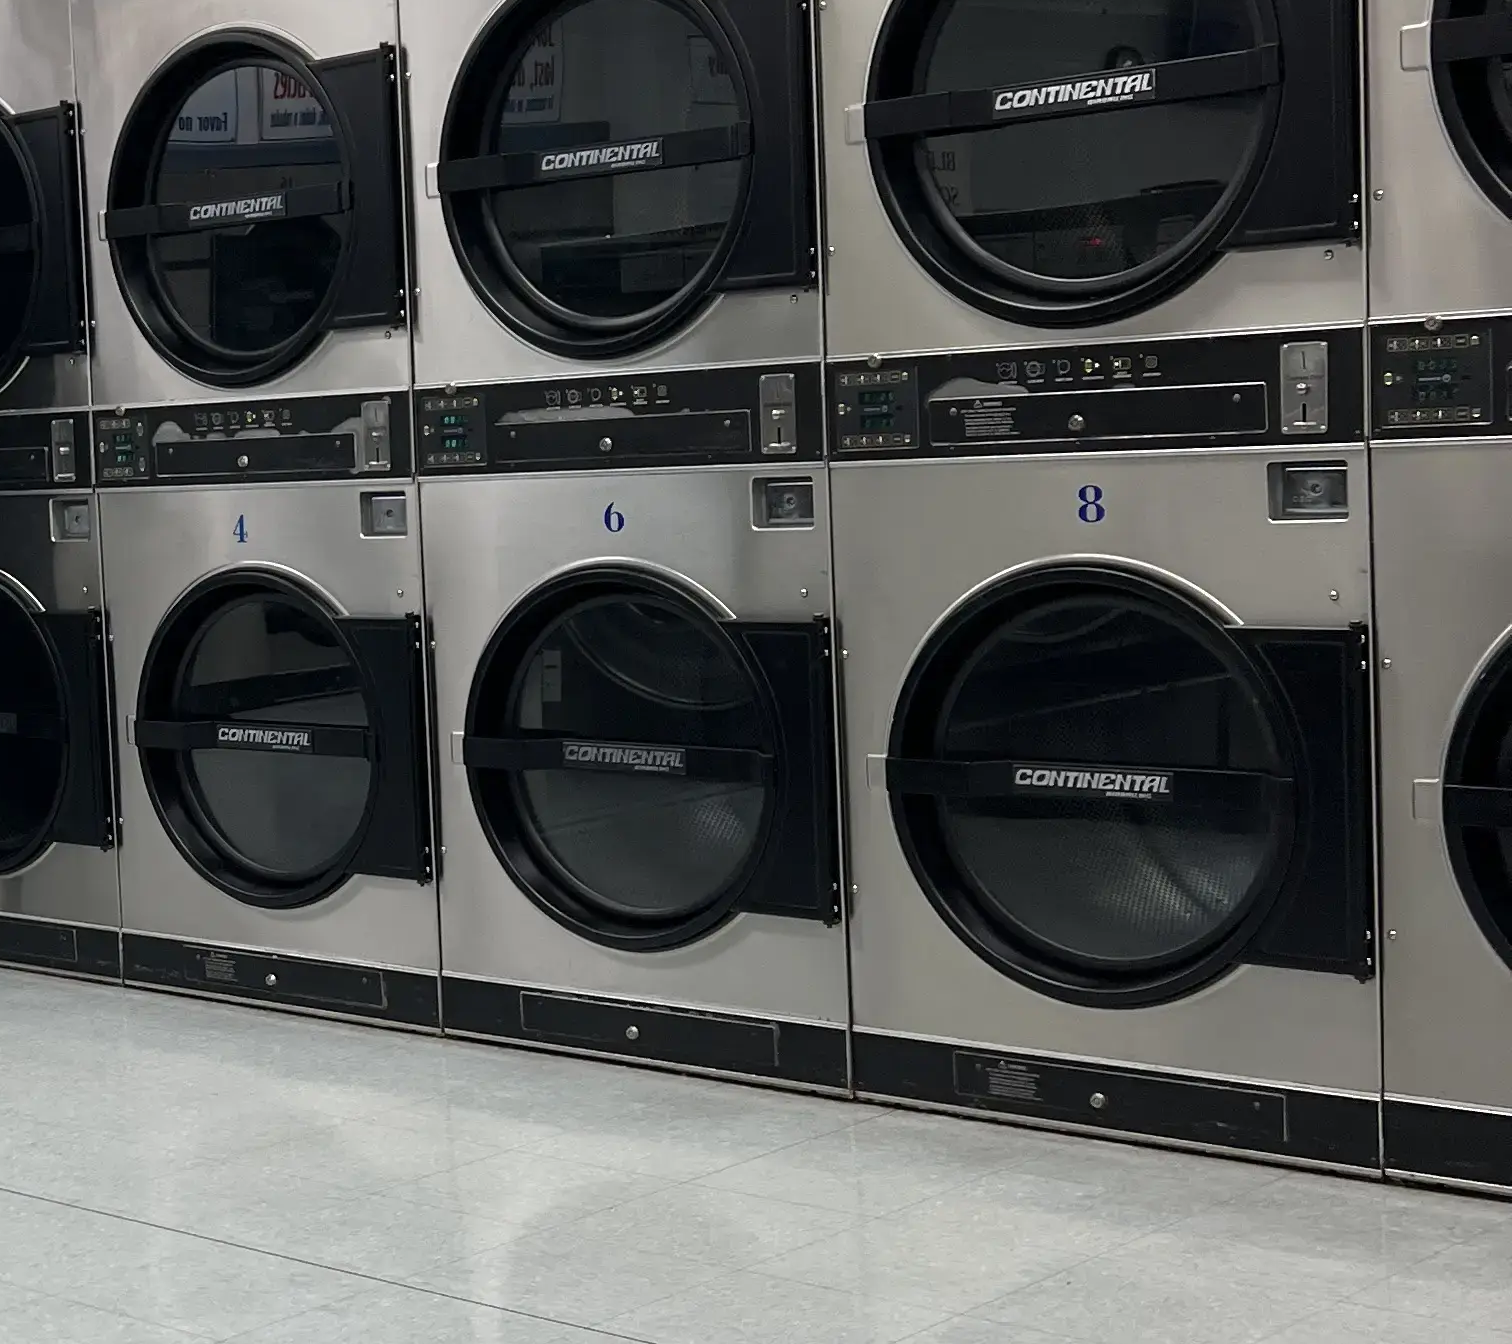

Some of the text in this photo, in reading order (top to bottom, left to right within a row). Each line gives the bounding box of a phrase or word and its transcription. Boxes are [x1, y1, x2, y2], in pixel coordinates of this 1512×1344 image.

[995, 73, 1153, 111] CONTINENTAL
[541, 141, 661, 171] CONTINENTAL
[190, 195, 284, 220] CONTINENTAL
[604, 502, 624, 533] 6
[1078, 485, 1106, 524] 8
[232, 513, 249, 544] 4
[218, 727, 311, 746] CONTINENTAL
[565, 745, 684, 767] CONTINENTAL
[1014, 769, 1170, 793] CONTINENTAL
